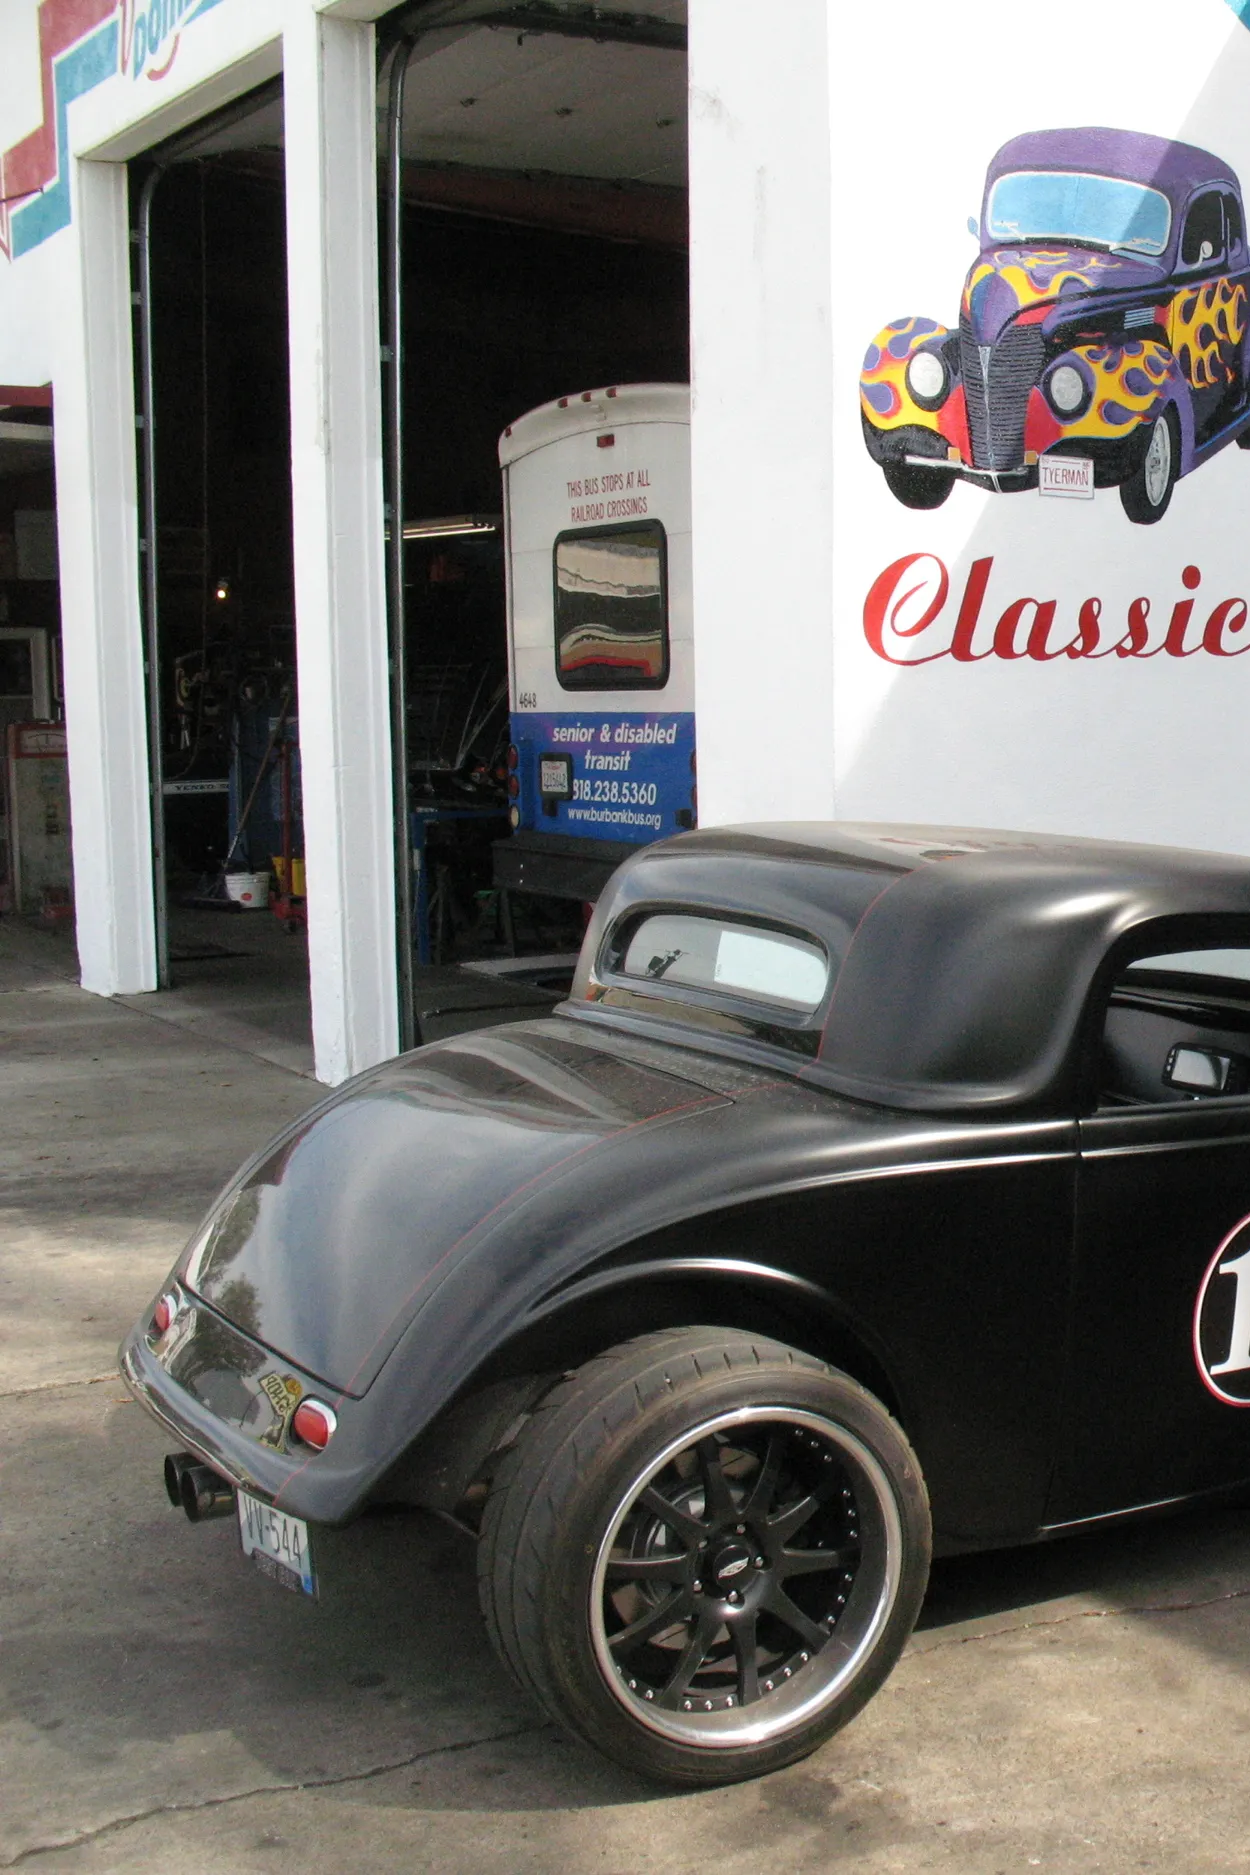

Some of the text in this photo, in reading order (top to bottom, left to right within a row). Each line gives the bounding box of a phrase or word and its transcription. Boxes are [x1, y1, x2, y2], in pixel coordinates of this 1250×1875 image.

[566, 469, 651, 499] THIS BUS STOPS AT ALL
[1042, 466, 1089, 486] TYERMAN
[571, 496, 648, 522] RAILROAD CROSSINGS
[552, 722, 677, 745] senior & disabled
[584, 750, 631, 771] transit
[568, 806, 661, 830] www.burbankbus.org
